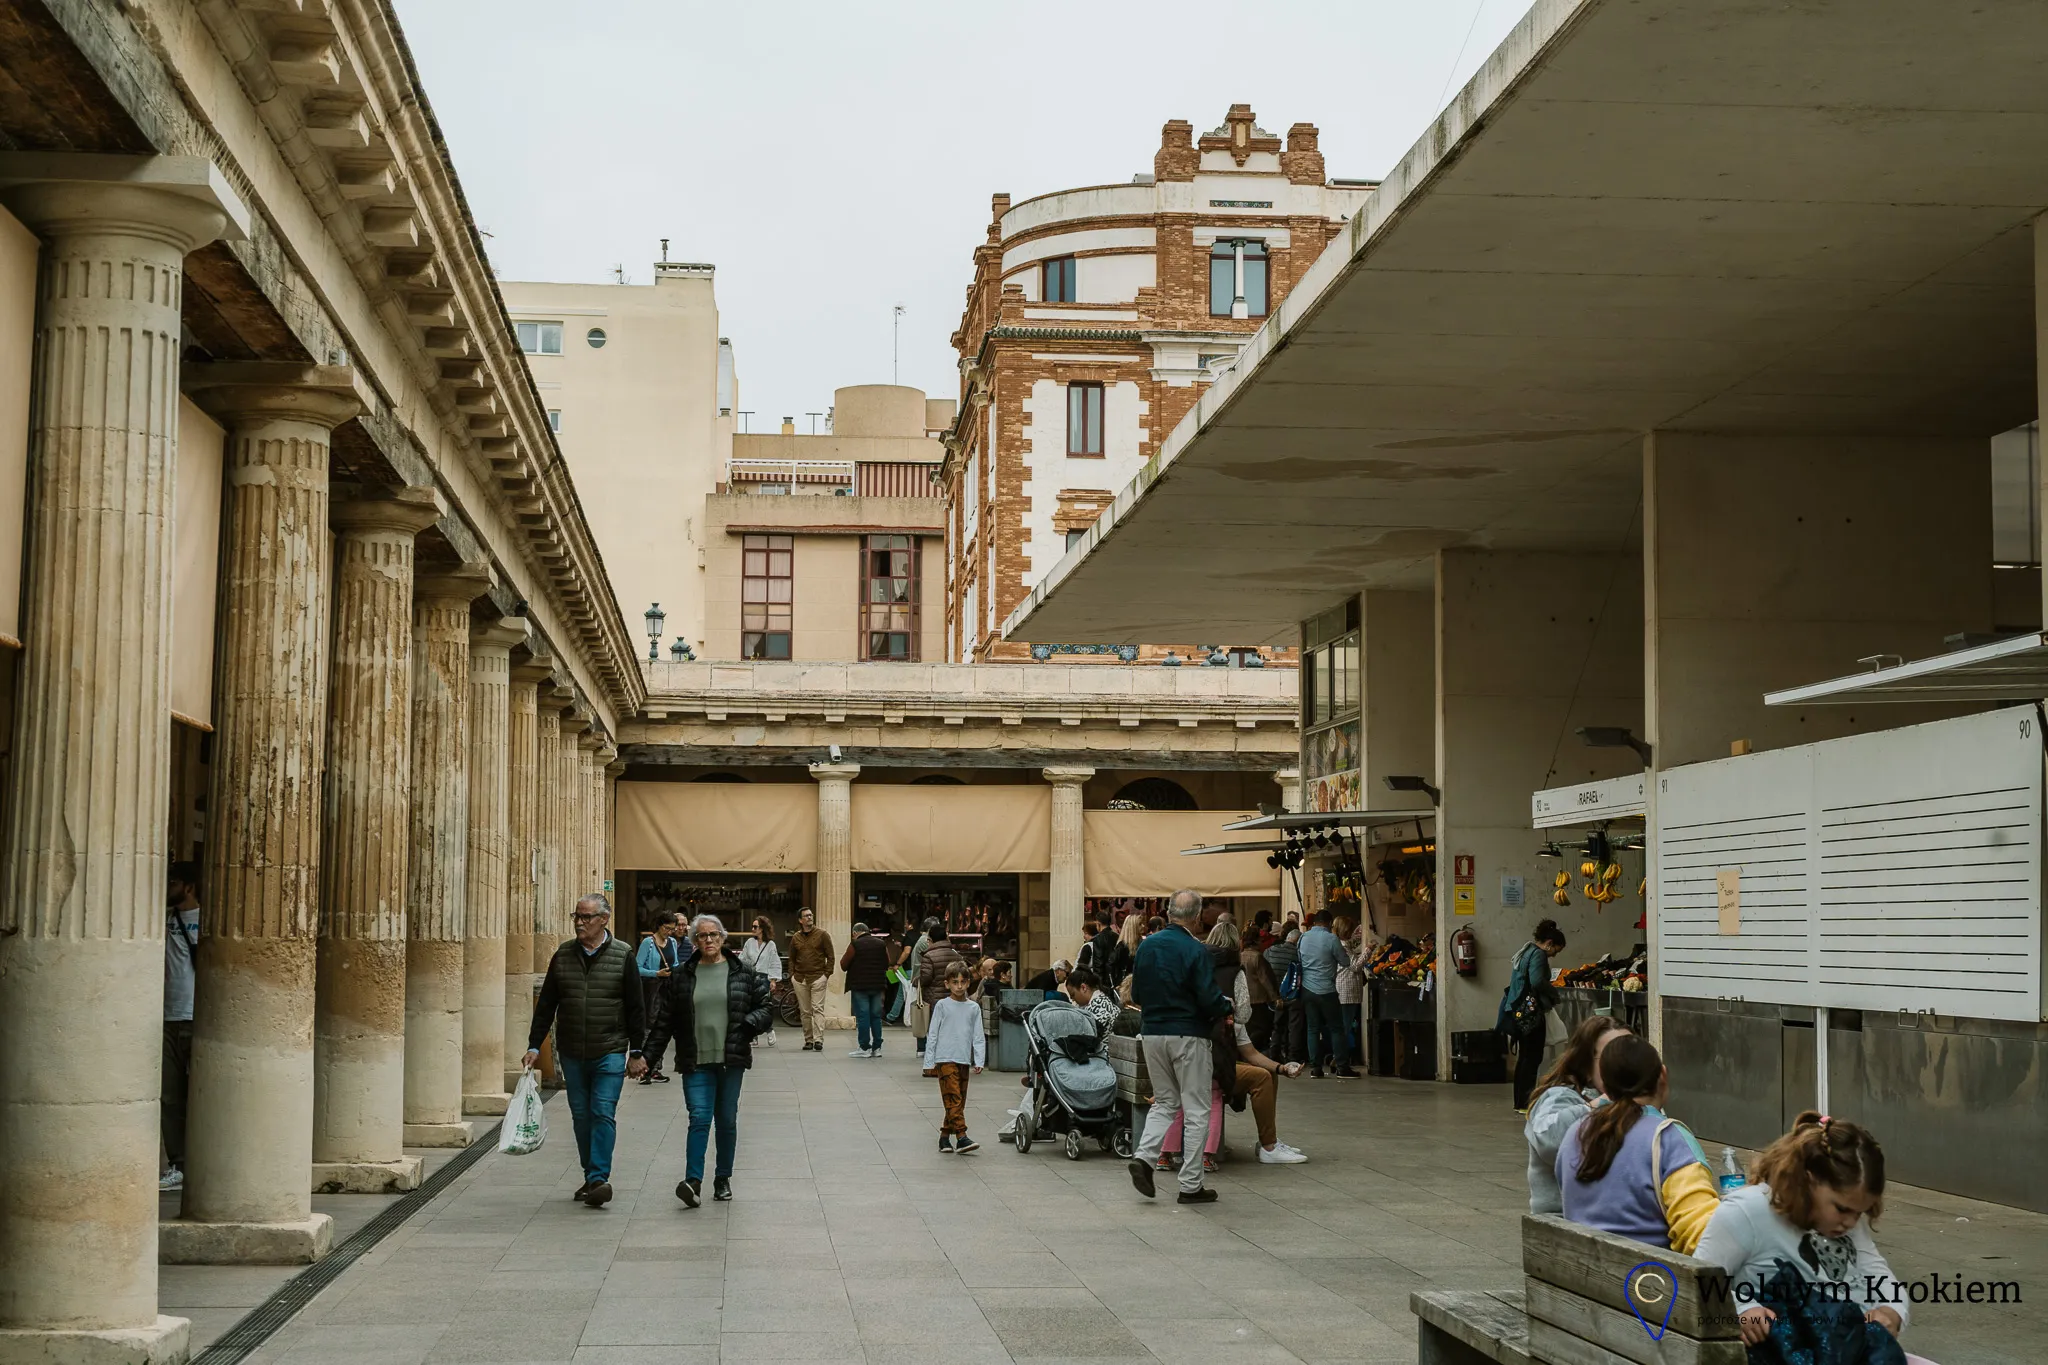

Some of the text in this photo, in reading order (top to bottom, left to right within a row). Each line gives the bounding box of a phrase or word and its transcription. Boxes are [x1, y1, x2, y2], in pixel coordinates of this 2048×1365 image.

[2019, 719, 2031, 739] 90
[1661, 778, 1668, 794] 91
[1578, 790, 1598, 805] RAFAEL
